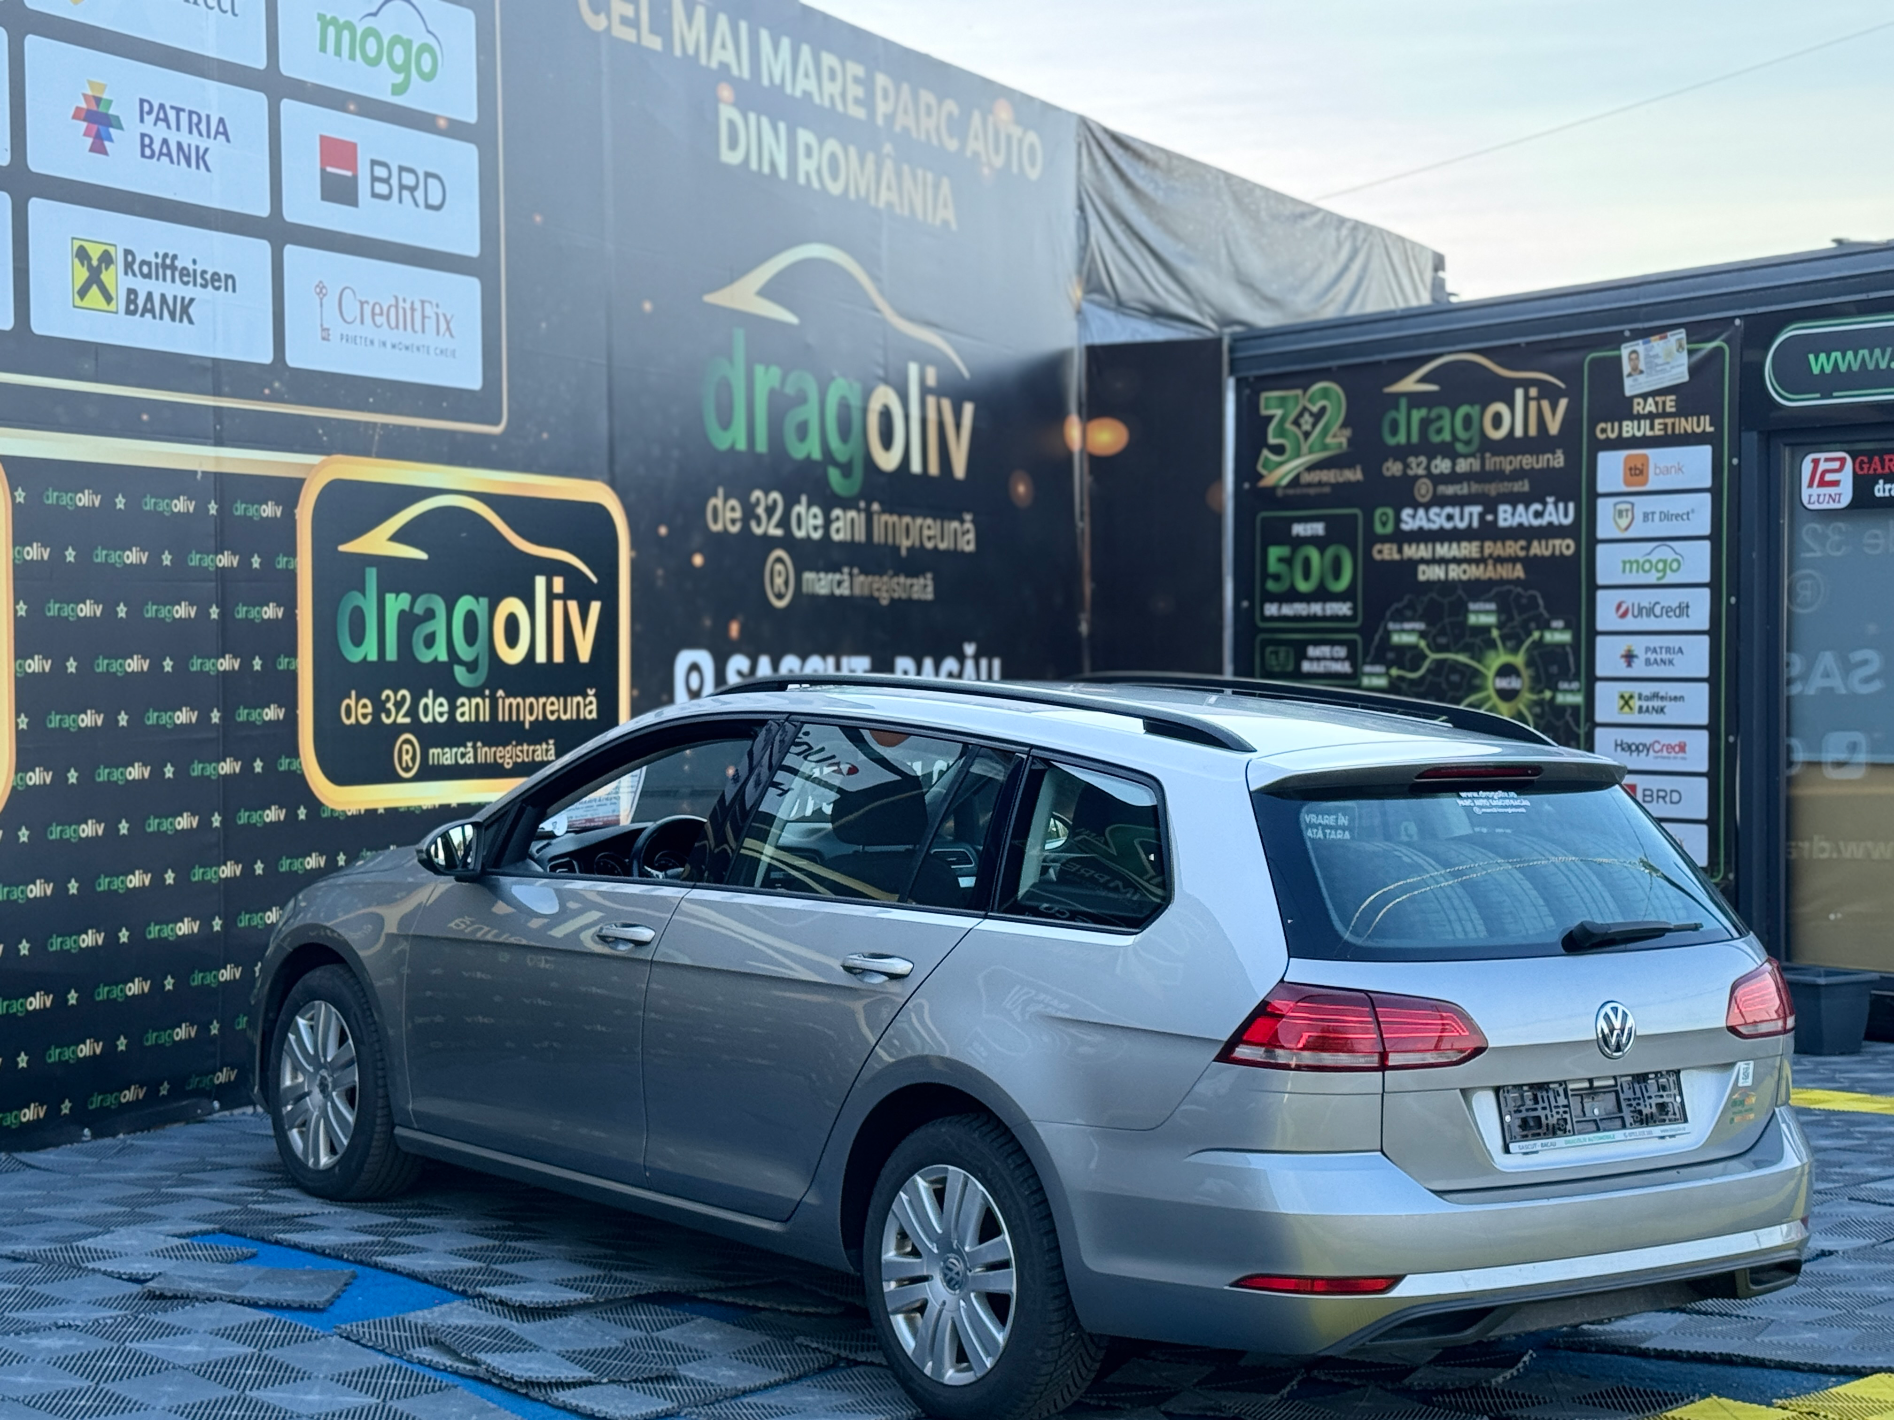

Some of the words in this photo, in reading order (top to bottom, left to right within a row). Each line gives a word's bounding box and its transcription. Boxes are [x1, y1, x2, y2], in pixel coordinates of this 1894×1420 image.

[316, 12, 439, 96] mogo
[671, 0, 750, 81] MAI
[759, 27, 867, 122] MARE
[874, 71, 960, 152] PARC
[965, 109, 1043, 181] AUTO
[138, 97, 231, 144] PATRIA
[139, 134, 212, 173] BANK
[717, 102, 788, 180] DIN
[796, 128, 957, 231] ROMÂNIA
[369, 157, 447, 213] BRD
[123, 248, 237, 294] Raiffeisen
[124, 288, 196, 326] BANK
[338, 286, 455, 339] CreditFix
[702, 327, 975, 498] dragoliv
[1382, 387, 1568, 454] dragoliv
[1632, 395, 1676, 415] RATE
[1256, 380, 1347, 478] 32
[1595, 421, 1618, 440] CU
[1622, 415, 1714, 438] BULETINUL
[1382, 458, 1403, 477] de
[1406, 455, 1428, 476] 32
[1430, 455, 1452, 474] de
[1455, 454, 1481, 473] ani
[1484, 449, 1565, 474] împreună
[1628, 463, 1645, 477] tbi
[1654, 461, 1685, 476] bank
[1806, 456, 1847, 489] 12
[43, 487, 101, 510] dragoliv
[142, 494, 195, 516] dragoliv
[233, 500, 283, 521] dragoliv
[1399, 505, 1484, 532] SASCUT
[1496, 496, 1576, 529] BACĂU
[1617, 508, 1630, 519] BT
[1807, 492, 1843, 505] LUNI
[706, 486, 742, 534] de
[750, 490, 784, 537] 32
[791, 494, 824, 540] de
[830, 500, 866, 543] ani
[871, 501, 976, 557] împreună
[1642, 511, 1656, 523] BT
[13, 542, 50, 564] goliv
[93, 546, 149, 568] dragoliv
[187, 550, 240, 571] dragoliv
[1372, 543, 1401, 561] CEL
[1402, 542, 1434, 560] MAI
[1435, 541, 1481, 560] MARE
[1483, 539, 1527, 558] PARC
[1529, 538, 1576, 556] AUTO
[1264, 545, 1354, 593] 500
[1417, 564, 1446, 581] DIN
[1447, 559, 1525, 581] ROMÂNIA
[1621, 557, 1681, 581] mogo
[802, 566, 851, 597] marcă
[852, 567, 935, 606] înregistrată
[45, 599, 103, 621] dragoliv
[143, 601, 197, 623] dragoliv
[234, 602, 284, 623] dragoliv
[1631, 601, 1690, 619] UniCredit
[337, 567, 601, 688] dragoliv
[94, 654, 150, 677] dragoliv
[189, 654, 241, 676] dragoliv
[1645, 646, 1684, 656] PATRIA
[1645, 658, 1675, 667] BANK
[340, 690, 373, 725] de
[381, 689, 411, 725] 32
[419, 689, 448, 723] de
[456, 689, 490, 723] ani
[496, 688, 598, 730] împreună
[1637, 692, 1685, 703] Raiffeisen
[1637, 705, 1667, 715] BANK
[46, 709, 104, 732] dragoliv
[144, 707, 198, 729] dragoliv
[235, 704, 286, 726] dragoliv
[429, 741, 474, 766] marcă
[477, 739, 556, 770] înregistrată
[1614, 739, 1687, 757] HappyCredit
[95, 762, 151, 785] dragoliv
[190, 757, 242, 780] dragoliv
[1642, 788, 1682, 805] BRD
[47, 819, 105, 843] dragoliv
[145, 812, 199, 835] dragoliv
[236, 805, 286, 827] dragoliv
[95, 870, 152, 893] dragoliv
[190, 861, 243, 884] dragoliv
[278, 852, 326, 874] dragoliv
[47, 929, 105, 953] dragoliv
[145, 917, 200, 941] dragoliv
[94, 977, 151, 1001] dragoliv
[189, 964, 242, 987] dragoliv
[46, 1038, 103, 1063] dragoliv
[143, 1023, 198, 1047] dragoliv
[87, 1084, 147, 1110] dragoliv
[185, 1067, 238, 1090] dragoliv
